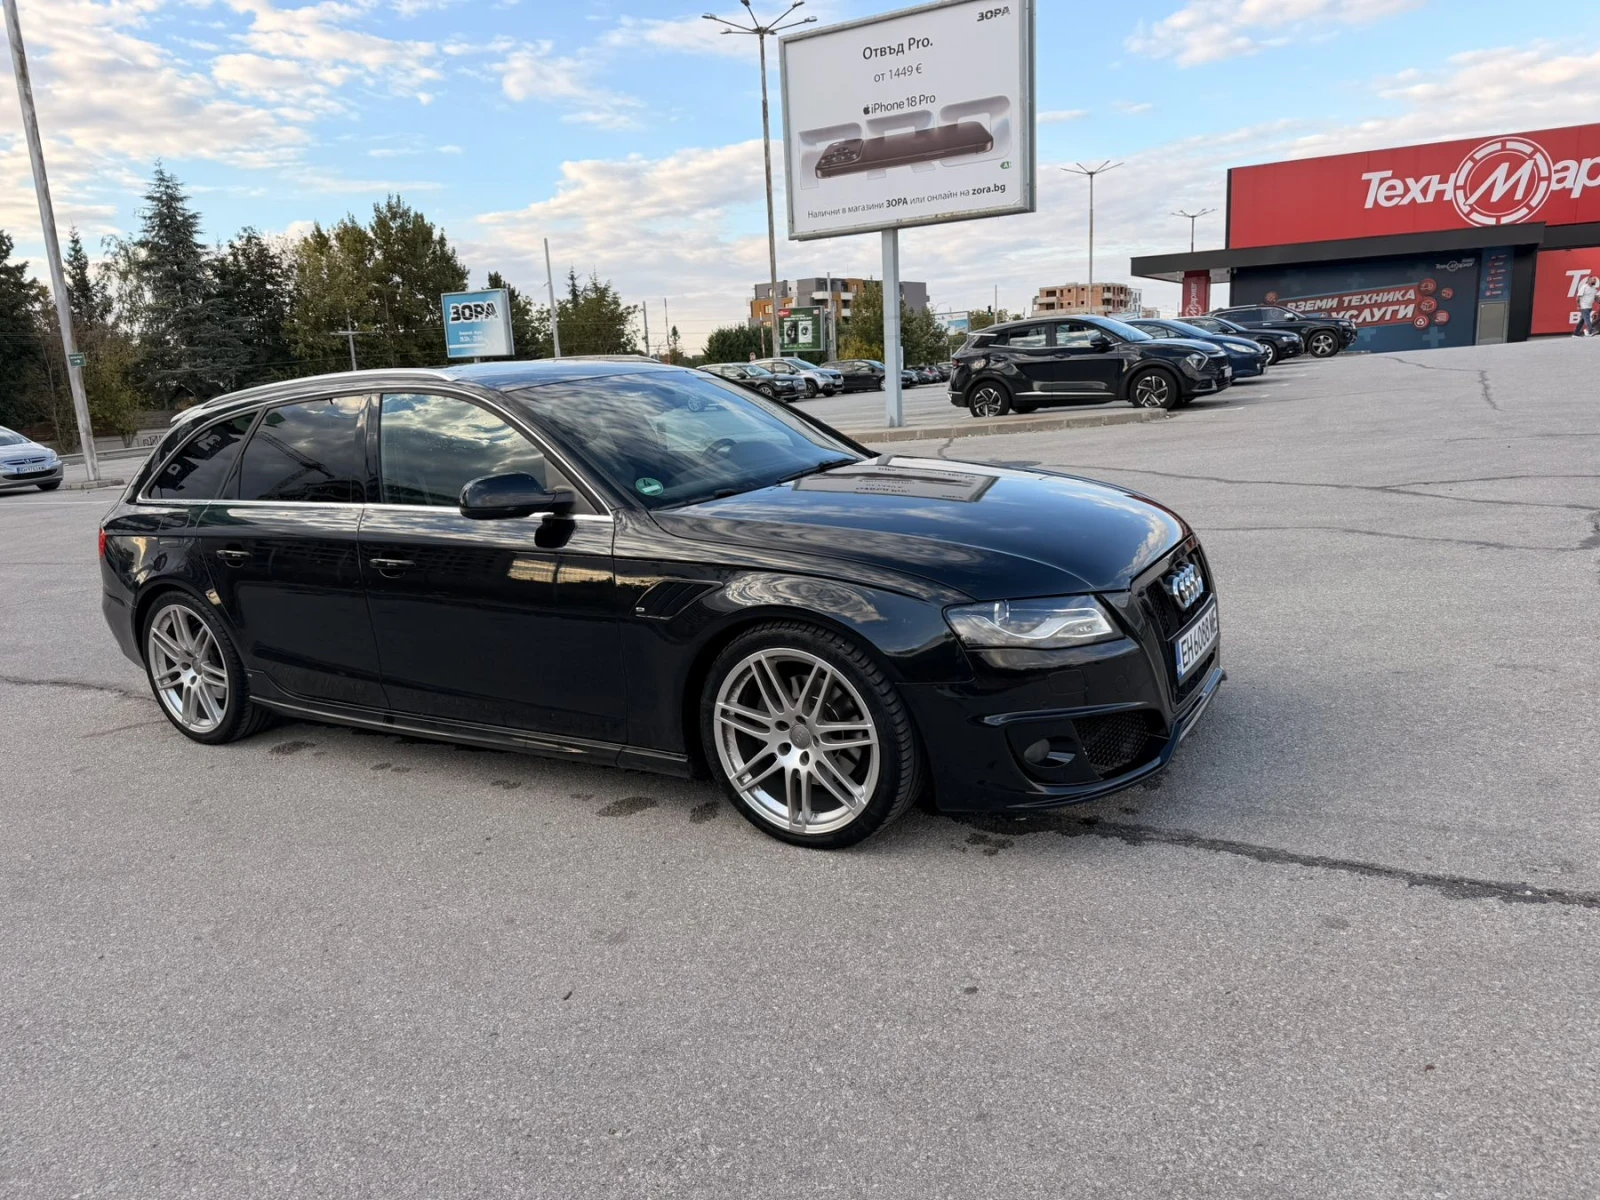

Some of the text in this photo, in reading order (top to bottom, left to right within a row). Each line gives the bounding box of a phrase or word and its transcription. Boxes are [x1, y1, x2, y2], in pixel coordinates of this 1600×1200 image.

[977, 6, 1011, 22] ЗОРА
[863, 37, 933, 60] Отвъд Pro.
[874, 63, 922, 82] от 1449 €
[871, 94, 936, 114] iPhone 18 Pro
[808, 208, 840, 219] Налични
[848, 202, 884, 213] магазини
[885, 197, 908, 208] ЗОРА
[910, 196, 925, 205] или
[927, 190, 957, 202] онлайн
[960, 189, 970, 197] на
[972, 183, 1006, 195] zora.bg
[1287, 289, 1415, 311] ВЗЕМИ ТЕХНИКА
[450, 302, 499, 323] ЗОРА
